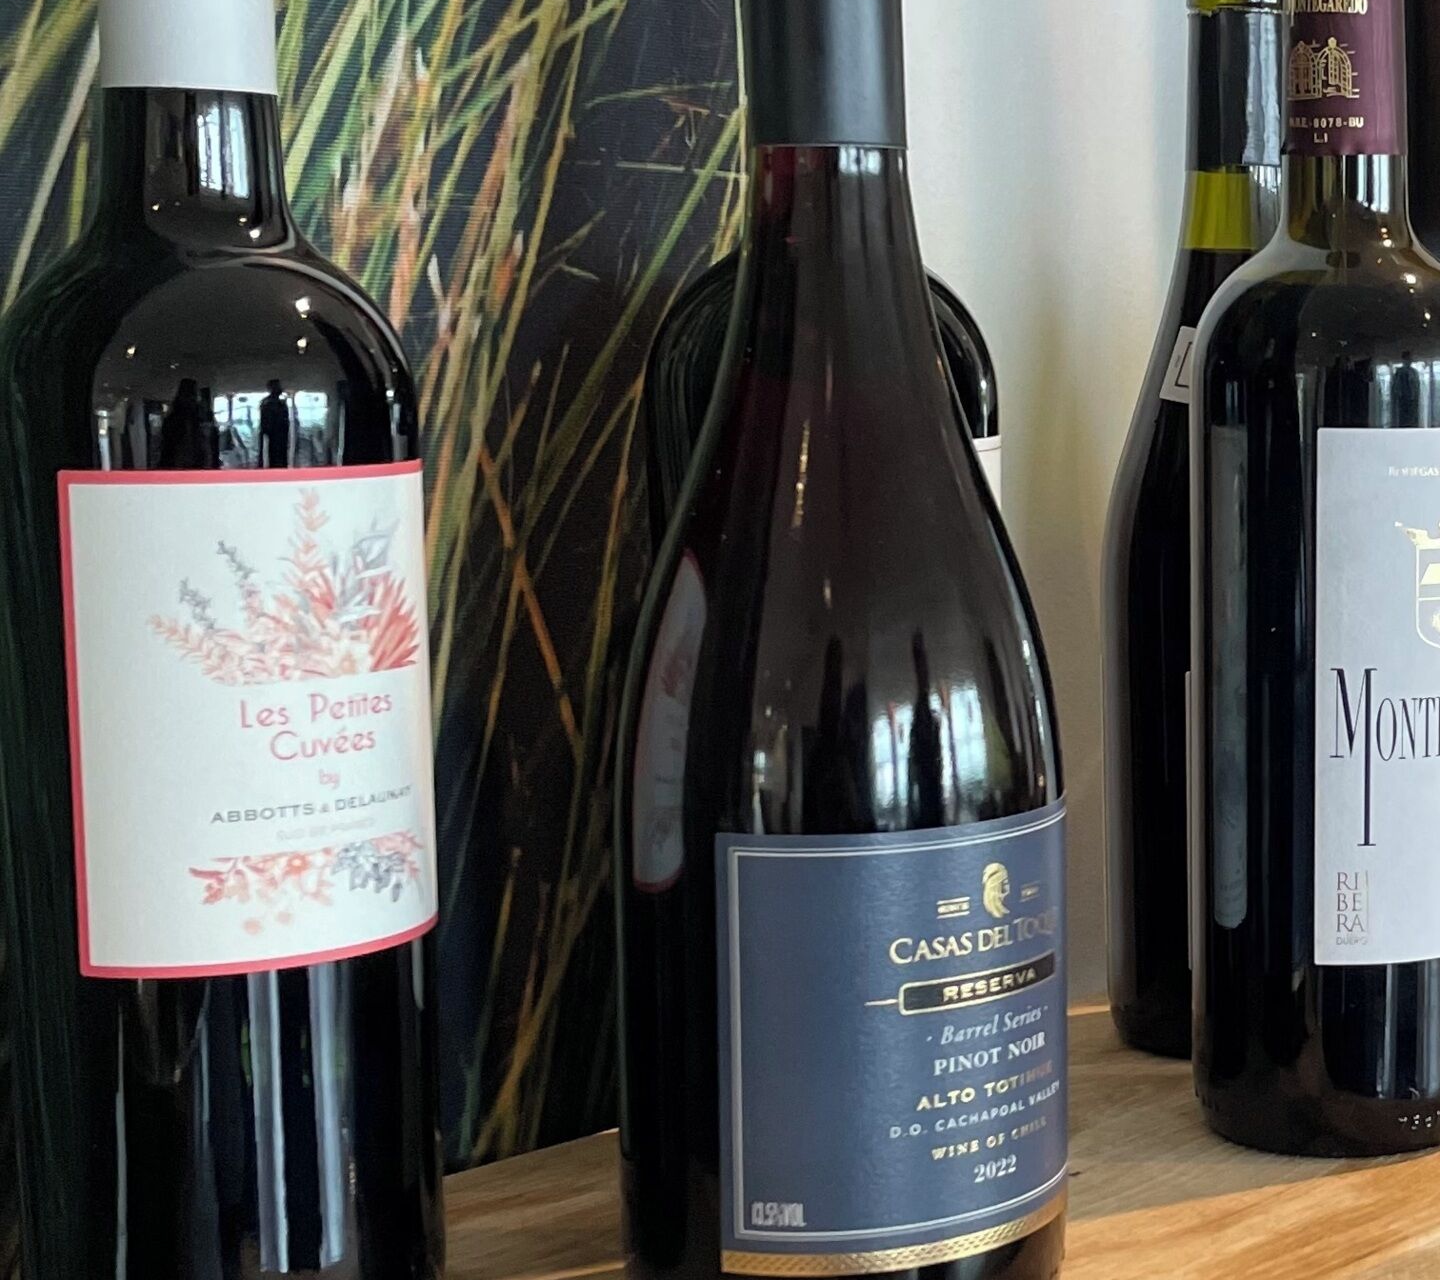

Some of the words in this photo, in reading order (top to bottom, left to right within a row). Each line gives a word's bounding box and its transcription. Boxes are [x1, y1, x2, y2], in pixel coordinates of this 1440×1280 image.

[239, 699, 290, 729] Les
[308, 692, 393, 723] Petites
[270, 726, 377, 761] Cuvées
[319, 769, 341, 790] by
[210, 803, 315, 825] ABBOTTS
[889, 931, 974, 965] CASAS
[976, 924, 1014, 953] DEL
[942, 967, 1038, 1002] RESERVA
[940, 1013, 1000, 1046] Barrel
[1002, 1004, 1043, 1033] Series
[932, 1046, 1002, 1077] PINOT
[1007, 1031, 1046, 1060] NOIR
[915, 1086, 976, 1112] ALTO
[934, 1100, 1026, 1133] CACHAPOAL
[931, 1139, 980, 1161] WINE
[985, 1132, 1006, 1150] OF
[973, 1153, 1017, 1183] 2022
